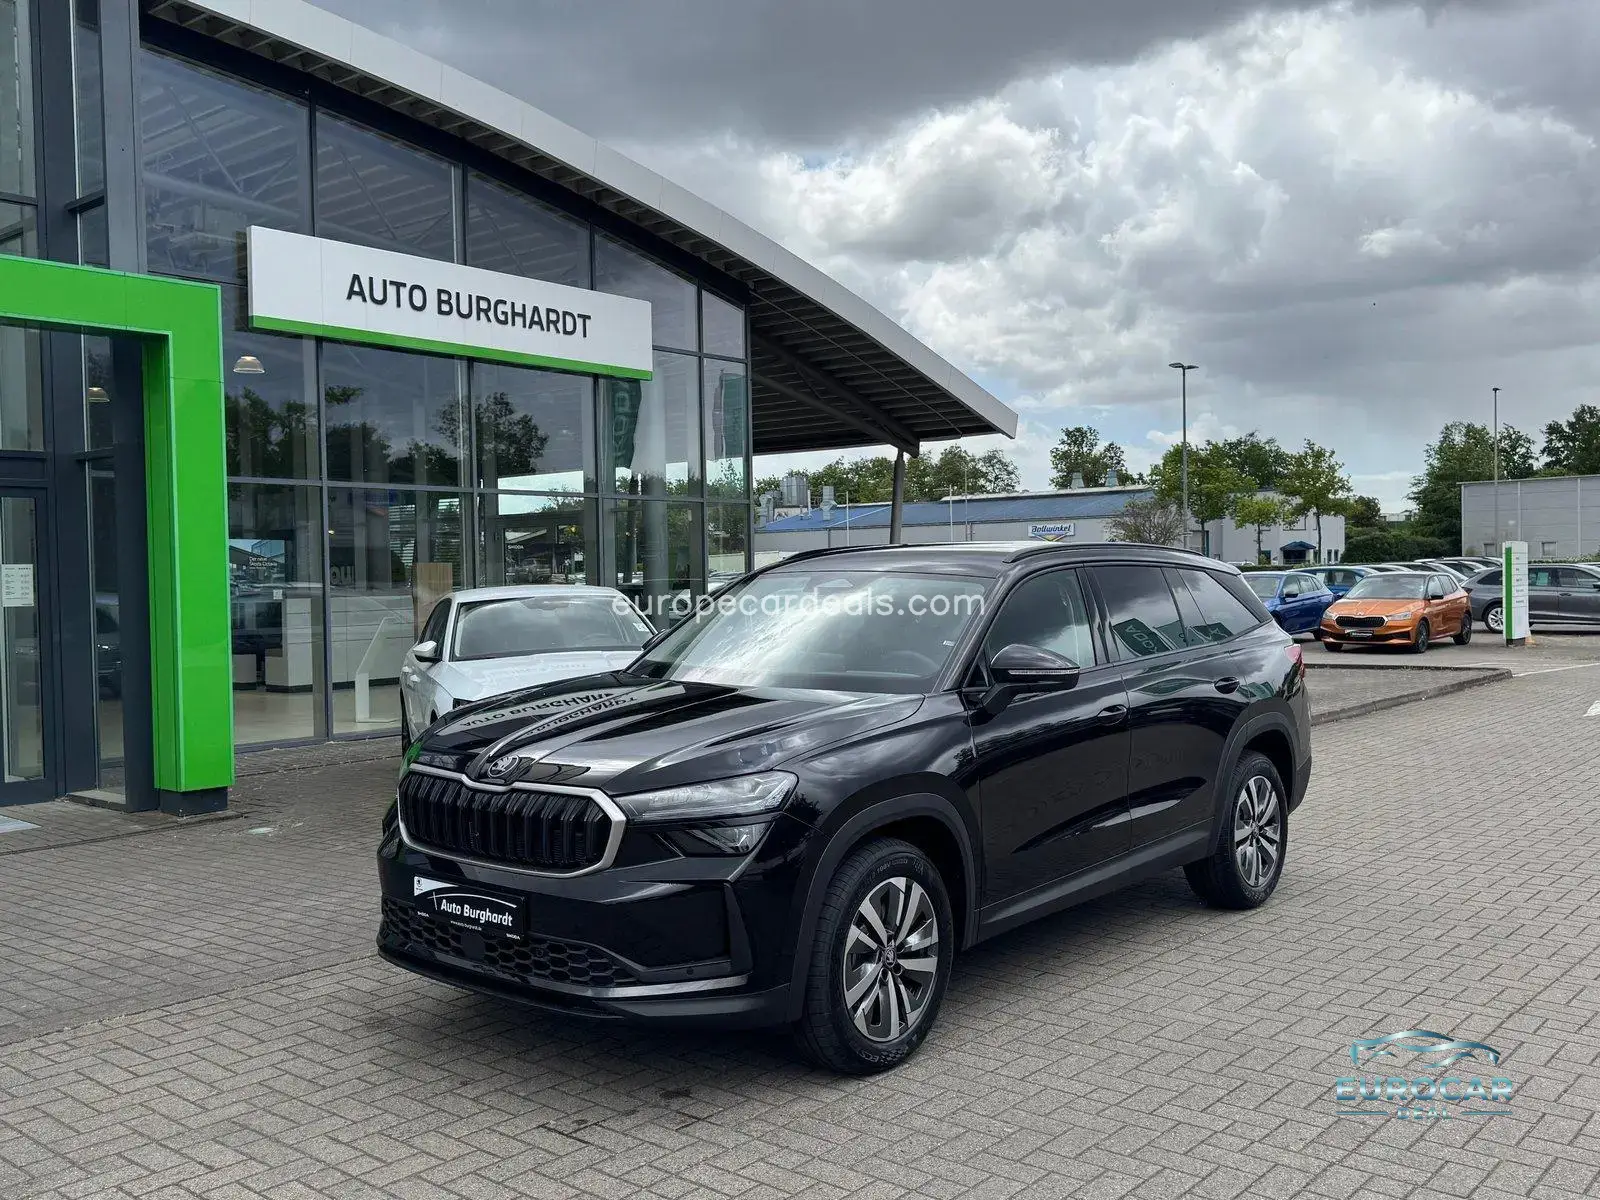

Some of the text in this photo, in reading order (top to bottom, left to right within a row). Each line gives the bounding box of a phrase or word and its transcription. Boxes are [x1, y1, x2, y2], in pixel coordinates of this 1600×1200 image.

[346, 273, 592, 338] AUTO BURGHARDT
[440, 899, 513, 927] Auto Burghardt
